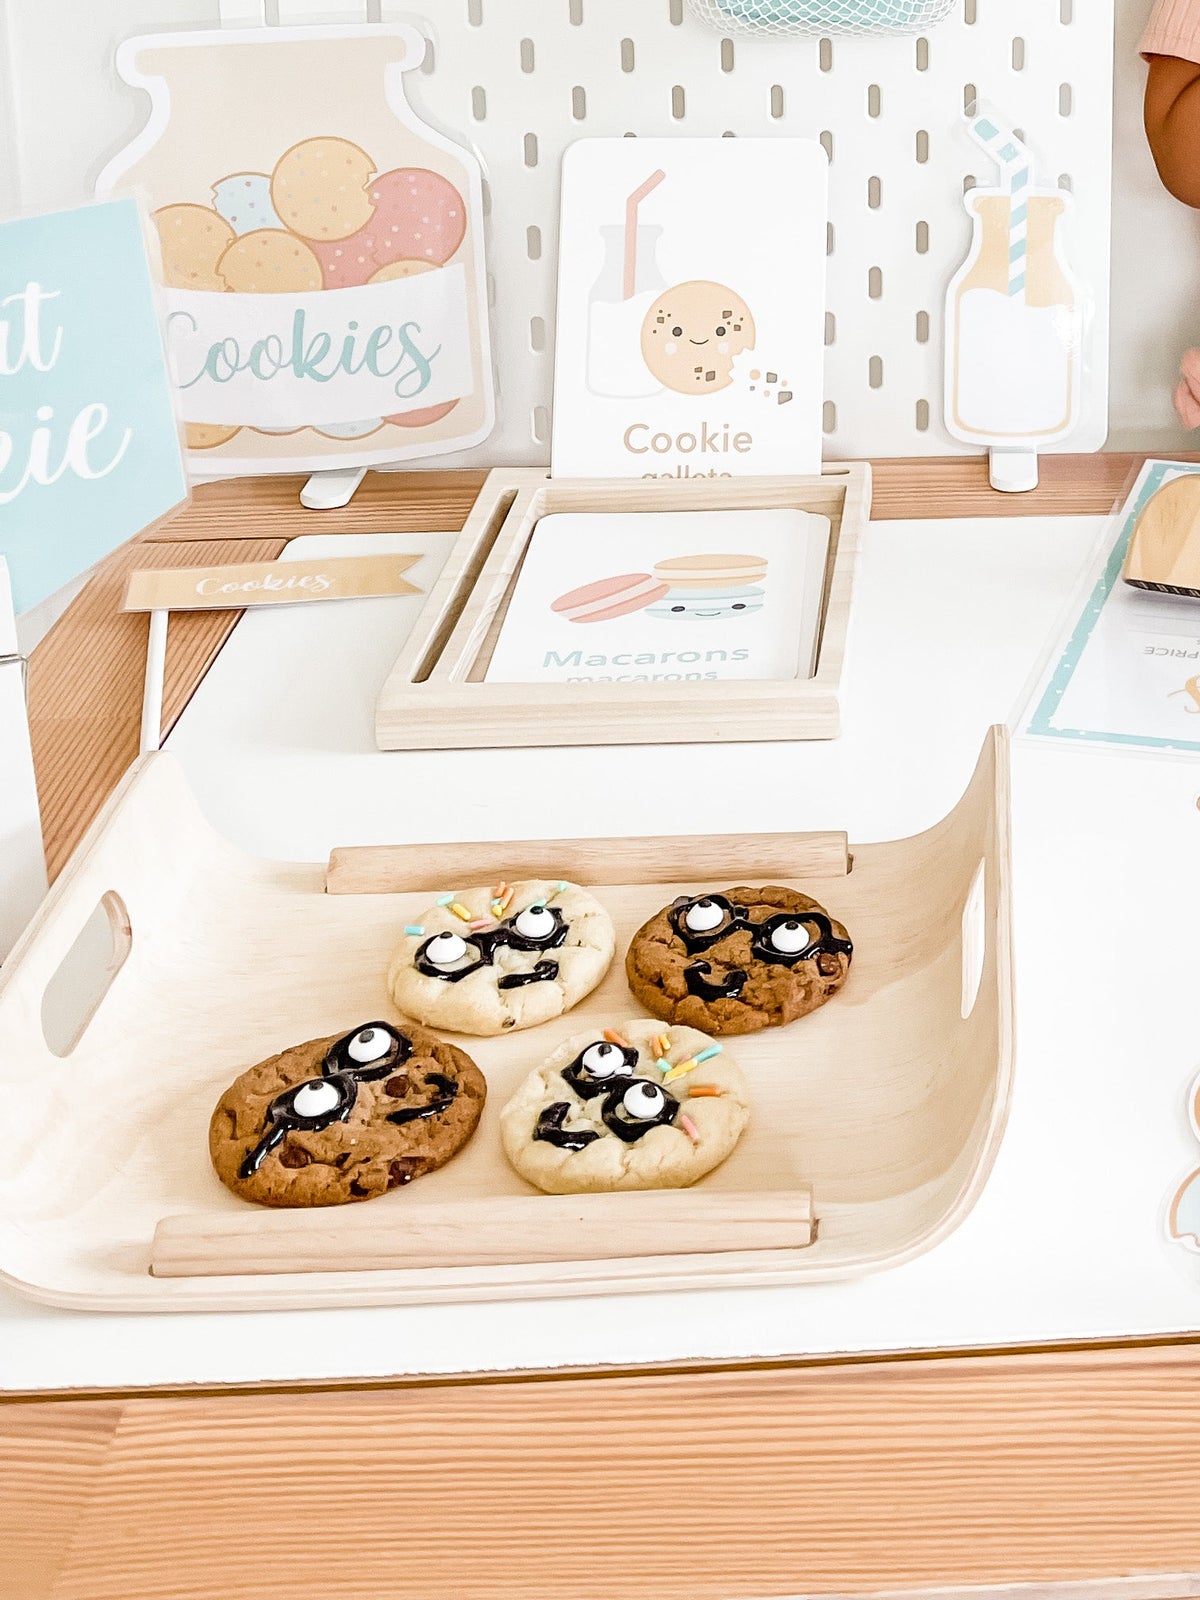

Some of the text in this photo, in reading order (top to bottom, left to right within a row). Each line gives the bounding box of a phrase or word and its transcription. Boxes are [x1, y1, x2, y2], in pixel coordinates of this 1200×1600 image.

[166, 308, 442, 399] Cookies
[623, 421, 753, 454] Cookie
[195, 573, 336, 596] Cookies
[541, 648, 750, 668] Macarons
[1144, 646, 1200, 660] PRICE
